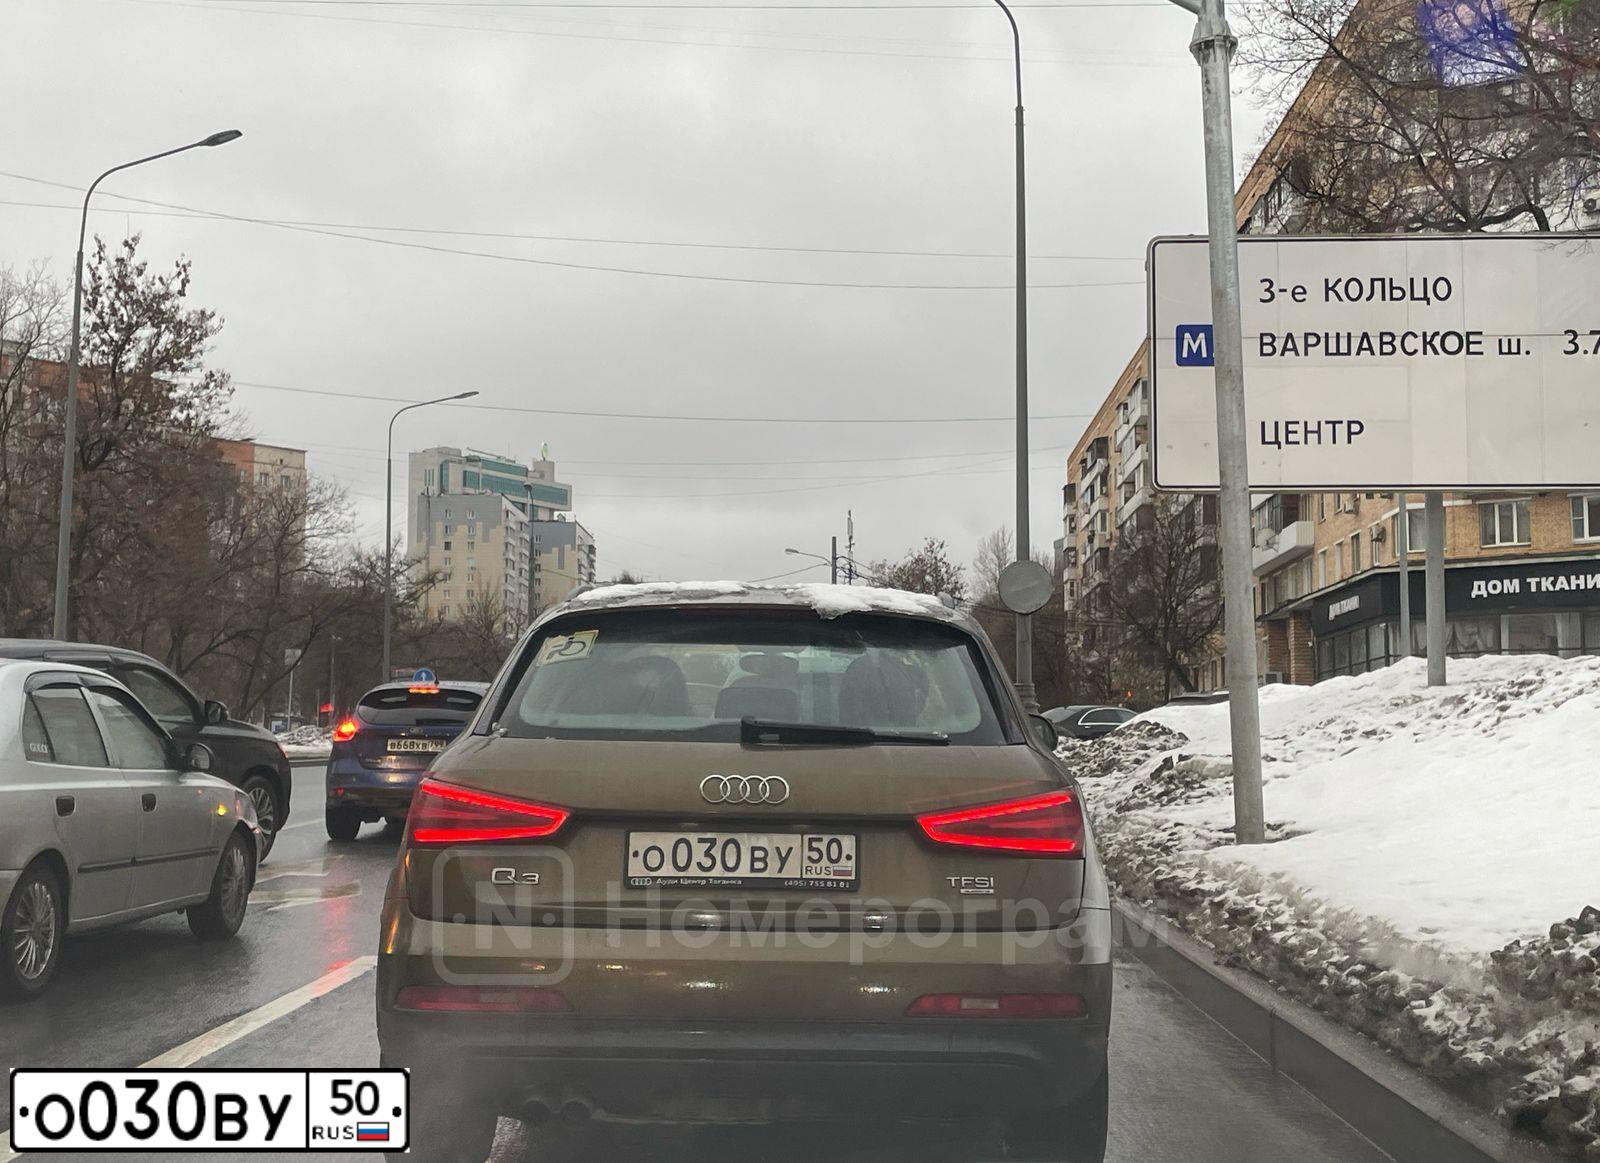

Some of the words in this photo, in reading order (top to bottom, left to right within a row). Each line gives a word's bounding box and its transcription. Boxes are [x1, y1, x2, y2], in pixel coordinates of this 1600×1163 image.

[1259, 278, 1308, 304] 3-е
[1324, 276, 1453, 306] КОЛЬЦО
[1259, 331, 1484, 357] ВАРШАВСКОЕ
[1498, 338, 1531, 356] ш.
[1260, 420, 1365, 450] ЦЕНТР
[1470, 578, 1520, 599] ДОМ
[1526, 573, 1600, 593] ТКАНИ
[642, 837, 794, 873] О030ВУ
[807, 837, 843, 864] 50
[491, 867, 540, 885] Q3
[804, 865, 832, 876] RUS
[946, 876, 994, 888] TFSI
